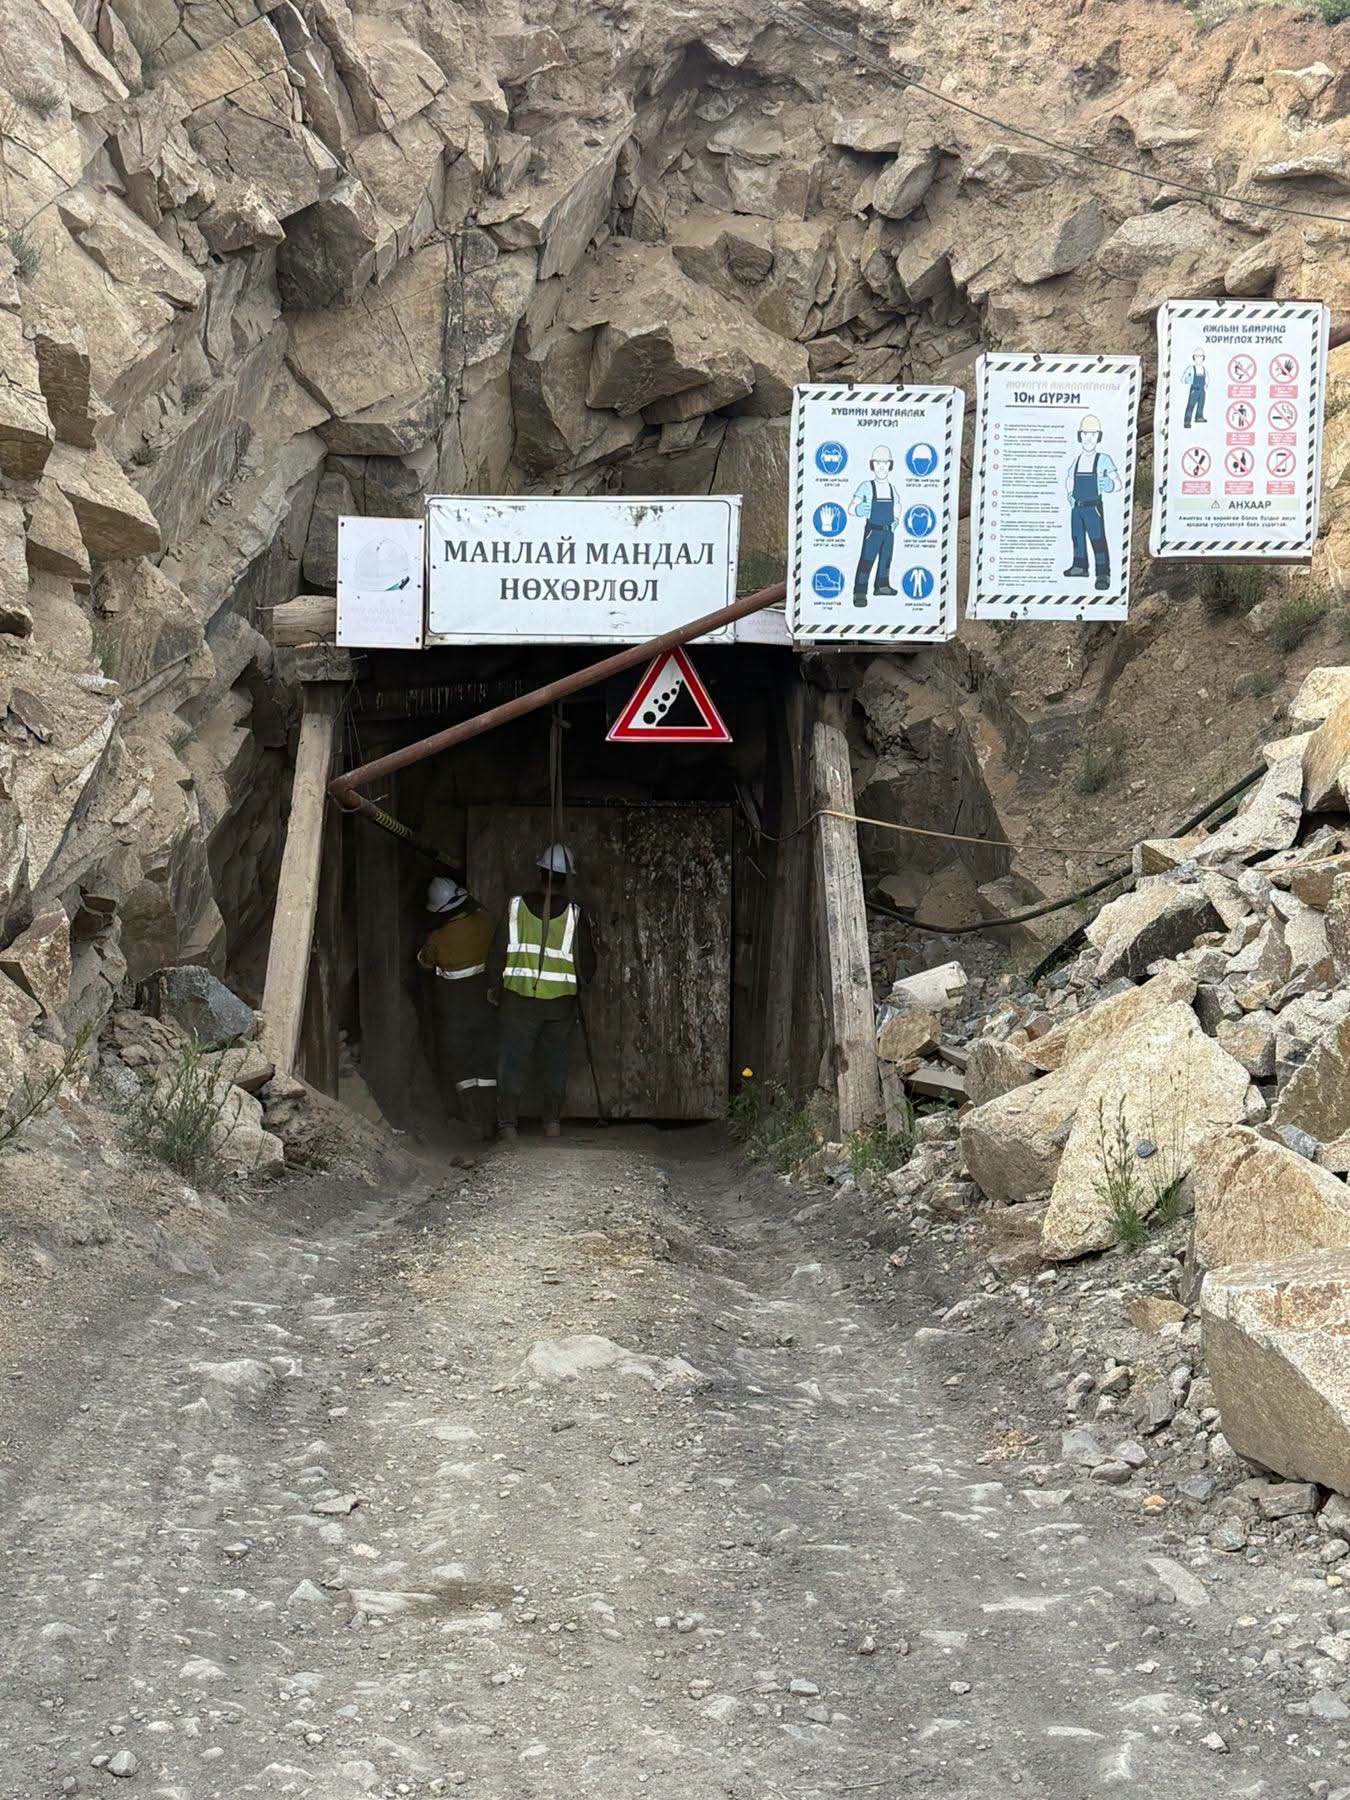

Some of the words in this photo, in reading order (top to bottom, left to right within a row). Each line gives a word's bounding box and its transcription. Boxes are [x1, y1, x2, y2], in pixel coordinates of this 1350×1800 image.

[1203, 324, 1239, 333] АЖЛЫН
[1242, 323, 1287, 334] БАЙРАНД
[1205, 335, 1252, 344] ХОРИГЛОХ
[1039, 392, 1081, 405] ДҮРЭМ
[831, 406, 868, 416] ХУВИЙН
[871, 407, 926, 418] ХАМГААЛАХ
[857, 418, 899, 428] ХЭРЭГСЭЛ
[1228, 500, 1272, 509] АНХААР
[444, 535, 577, 565] МАНЛАЙ
[586, 541, 715, 570] МАНДАЛ
[499, 577, 659, 602] НӨХӨРЛӨЛ
